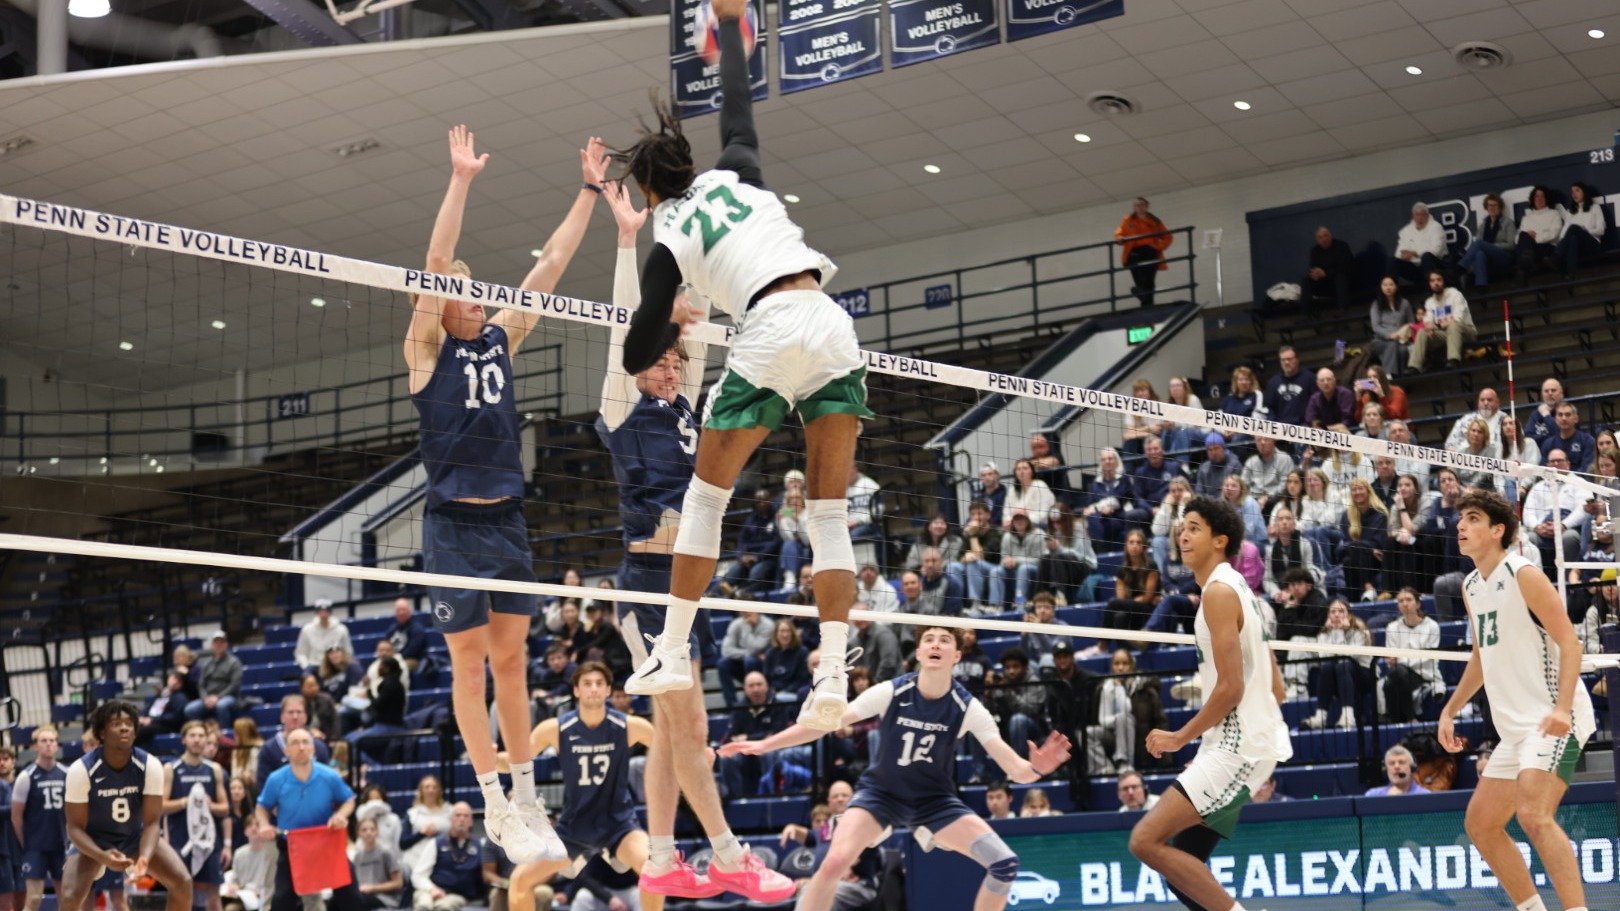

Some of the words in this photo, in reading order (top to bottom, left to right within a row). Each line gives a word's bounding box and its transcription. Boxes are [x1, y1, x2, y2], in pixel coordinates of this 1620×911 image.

[789, 4, 824, 20] 2002
[907, 12, 983, 39] VOLLEYBALL
[925, 3, 963, 21] MEN'S
[794, 40, 866, 67] VOLLEYBALL
[811, 31, 849, 50] MEN'S
[1590, 149, 1614, 163] 213
[681, 185, 753, 256] 23
[16, 200, 86, 229] PENN
[95, 215, 170, 245] STATE
[180, 229, 330, 273] VOLLEYBALL
[405, 270, 463, 295] PENN
[470, 281, 532, 308] STATE
[540, 293, 628, 324] VOLLEYB
[464, 362, 505, 409] 10
[988, 373, 1027, 393] PENN
[1032, 381, 1074, 401] STATE
[1080, 388, 1164, 416] VOLLEYBALL
[282, 398, 306, 416] 211
[1205, 410, 1239, 428] PENN
[1242, 417, 1278, 435] STATE
[1282, 423, 1352, 447] VOLLEYBALL
[1387, 441, 1414, 458] PENN
[1418, 447, 1447, 463] STATE
[1451, 452, 1510, 474] VOLLEYBALL
[1477, 610, 1499, 648] 13
[896, 717, 924, 729] PENN
[924, 722, 949, 731] STATE
[572, 745, 593, 753] PENN
[593, 743, 615, 753] STATE
[897, 731, 936, 766] 12
[578, 754, 610, 786] 13
[43, 787, 63, 810] 15
[98, 788, 118, 797] PENN
[112, 798, 130, 823] 8
